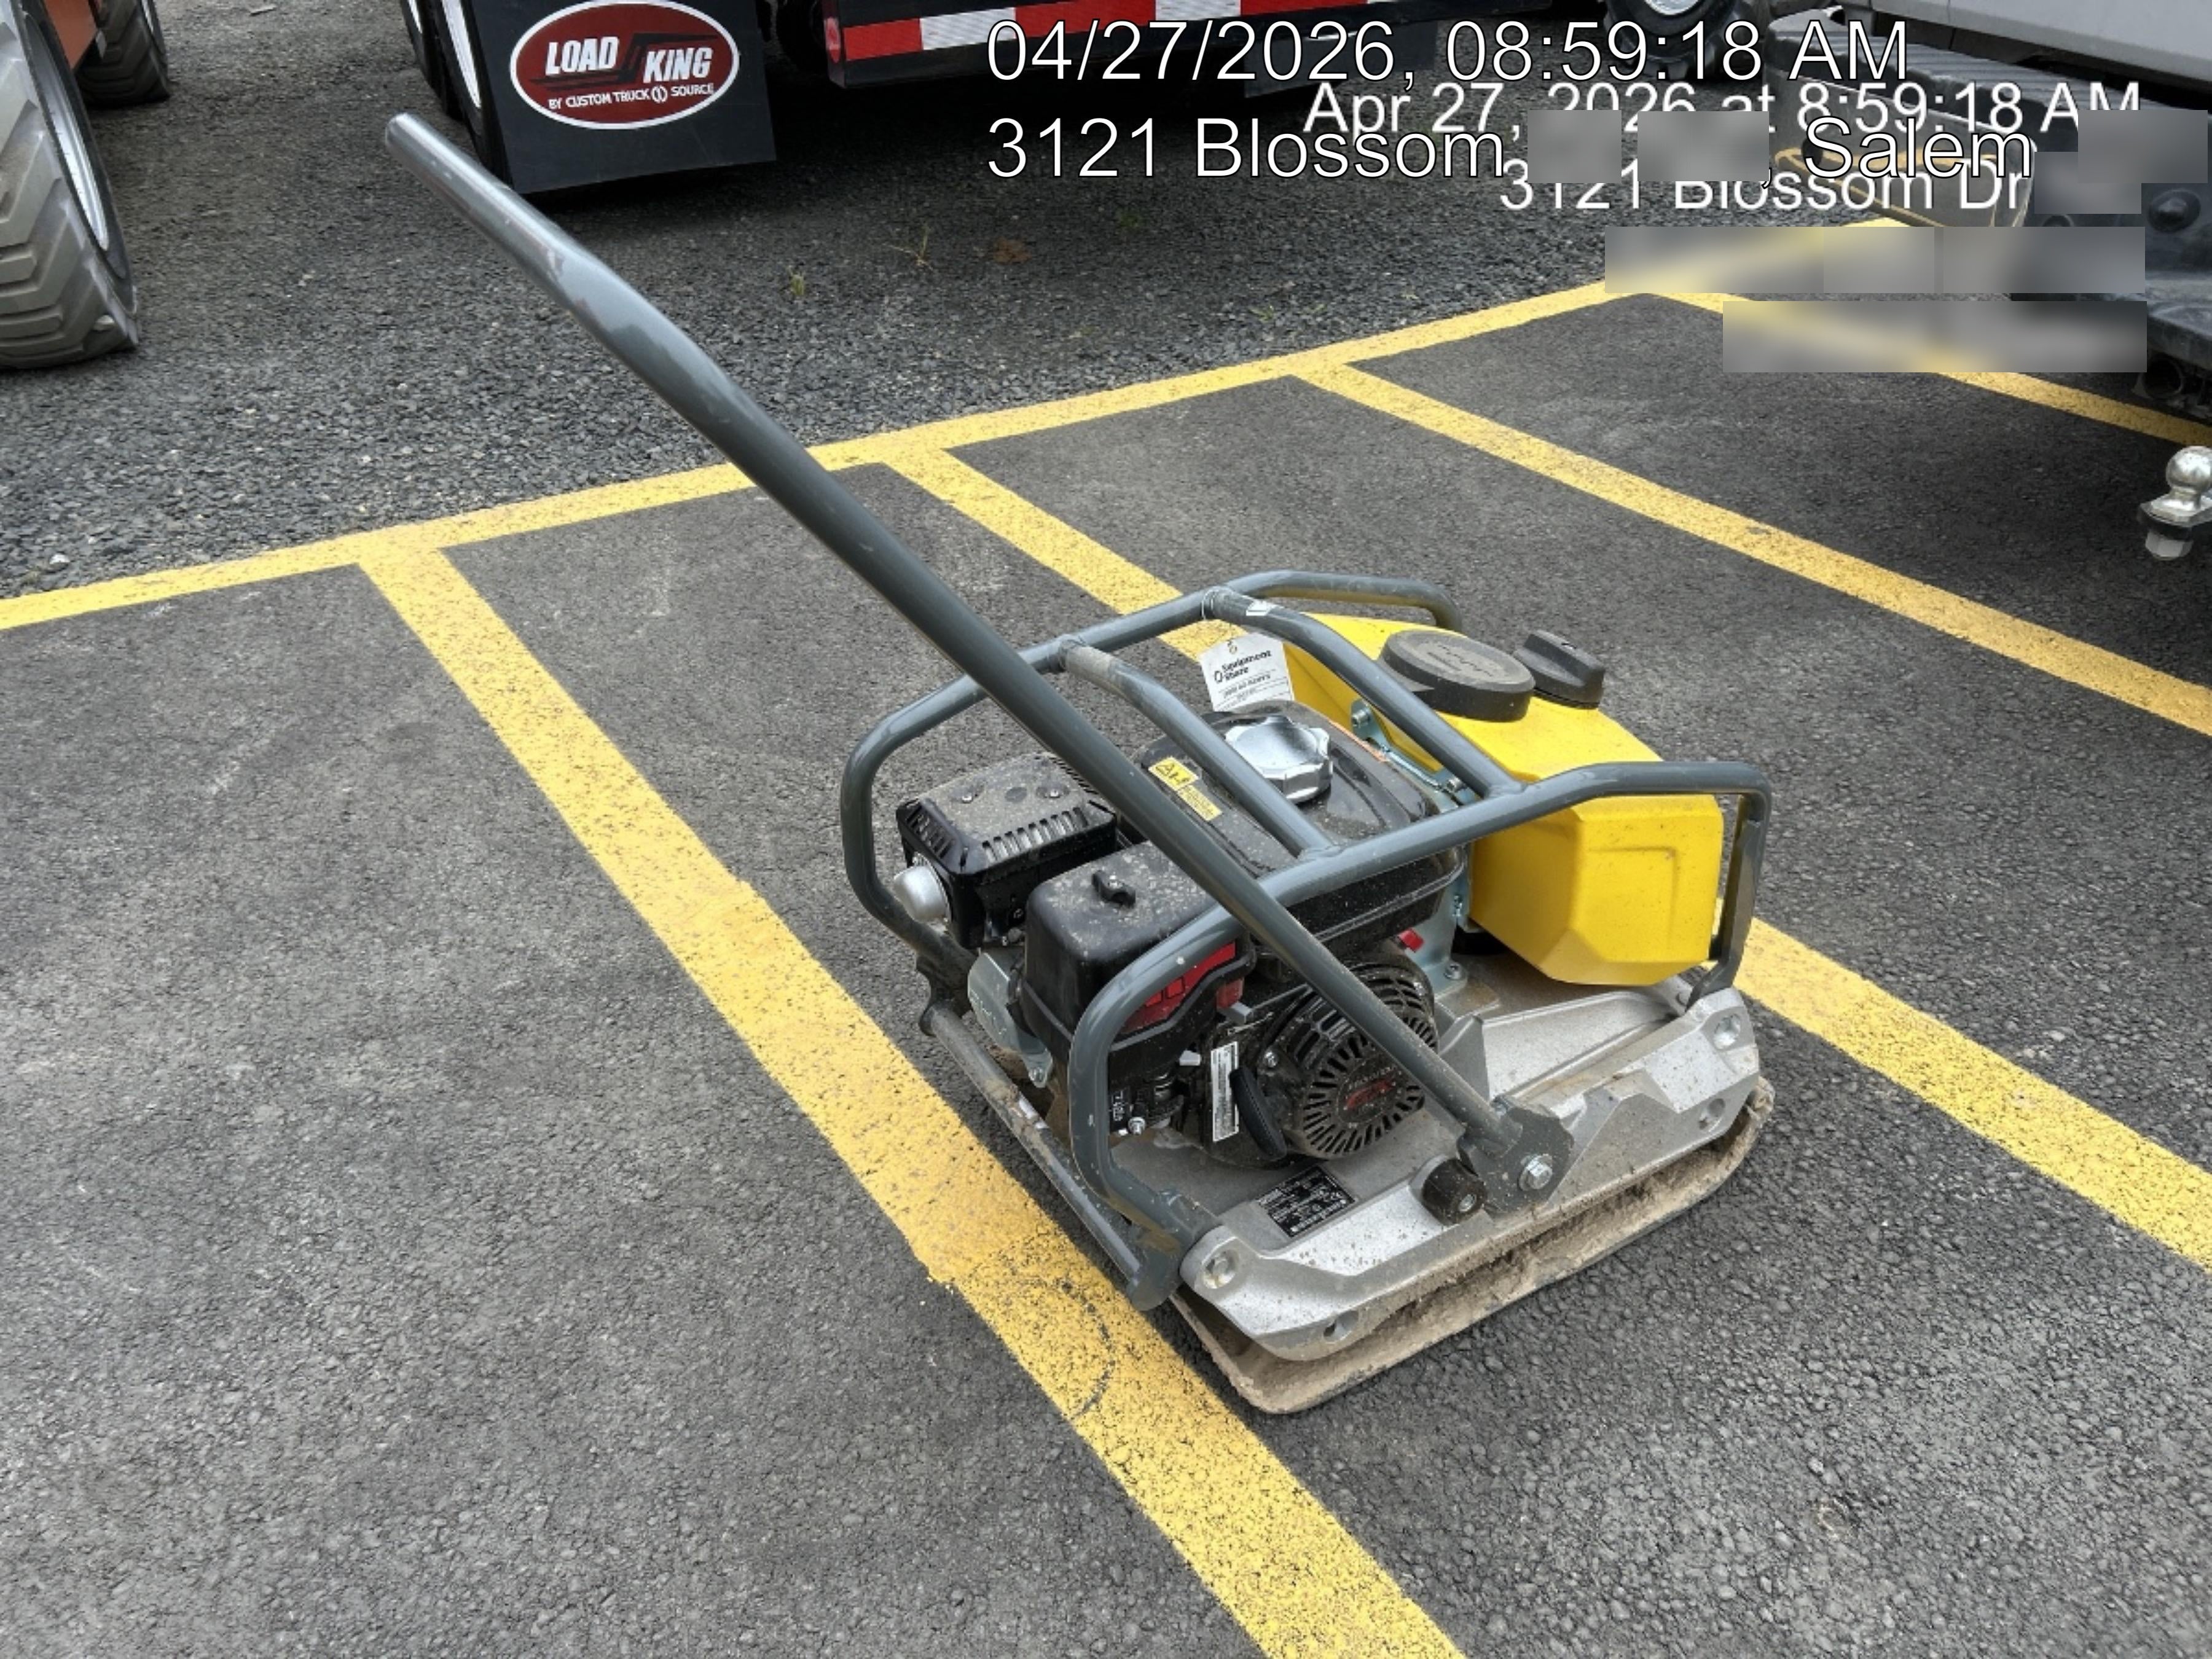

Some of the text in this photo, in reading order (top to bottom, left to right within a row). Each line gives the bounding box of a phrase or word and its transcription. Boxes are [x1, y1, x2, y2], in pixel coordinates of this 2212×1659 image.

[545, 36, 713, 84] LOAD KING
[548, 82, 715, 109] BY CUSTOM TRUCK SOURCE
